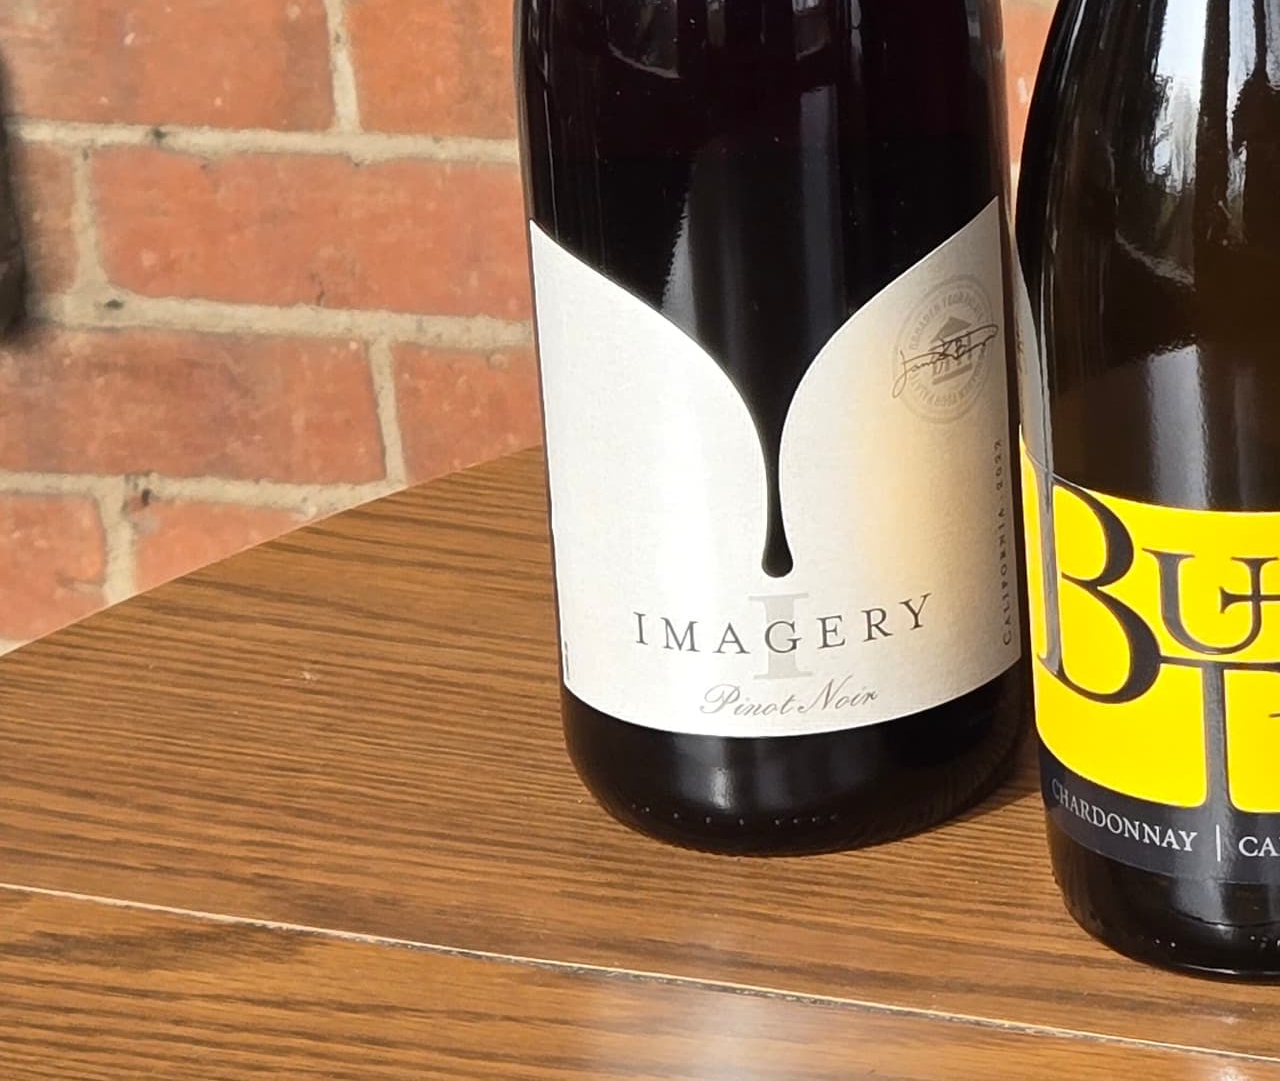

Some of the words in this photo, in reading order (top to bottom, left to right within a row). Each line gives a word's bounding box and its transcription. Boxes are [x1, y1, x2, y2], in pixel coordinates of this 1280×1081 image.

[633, 592, 932, 655] IMAGERY
[699, 682, 793, 717] Pinot
[798, 674, 879, 713] Noir
[1051, 776, 1198, 853] CHARDONNAY
